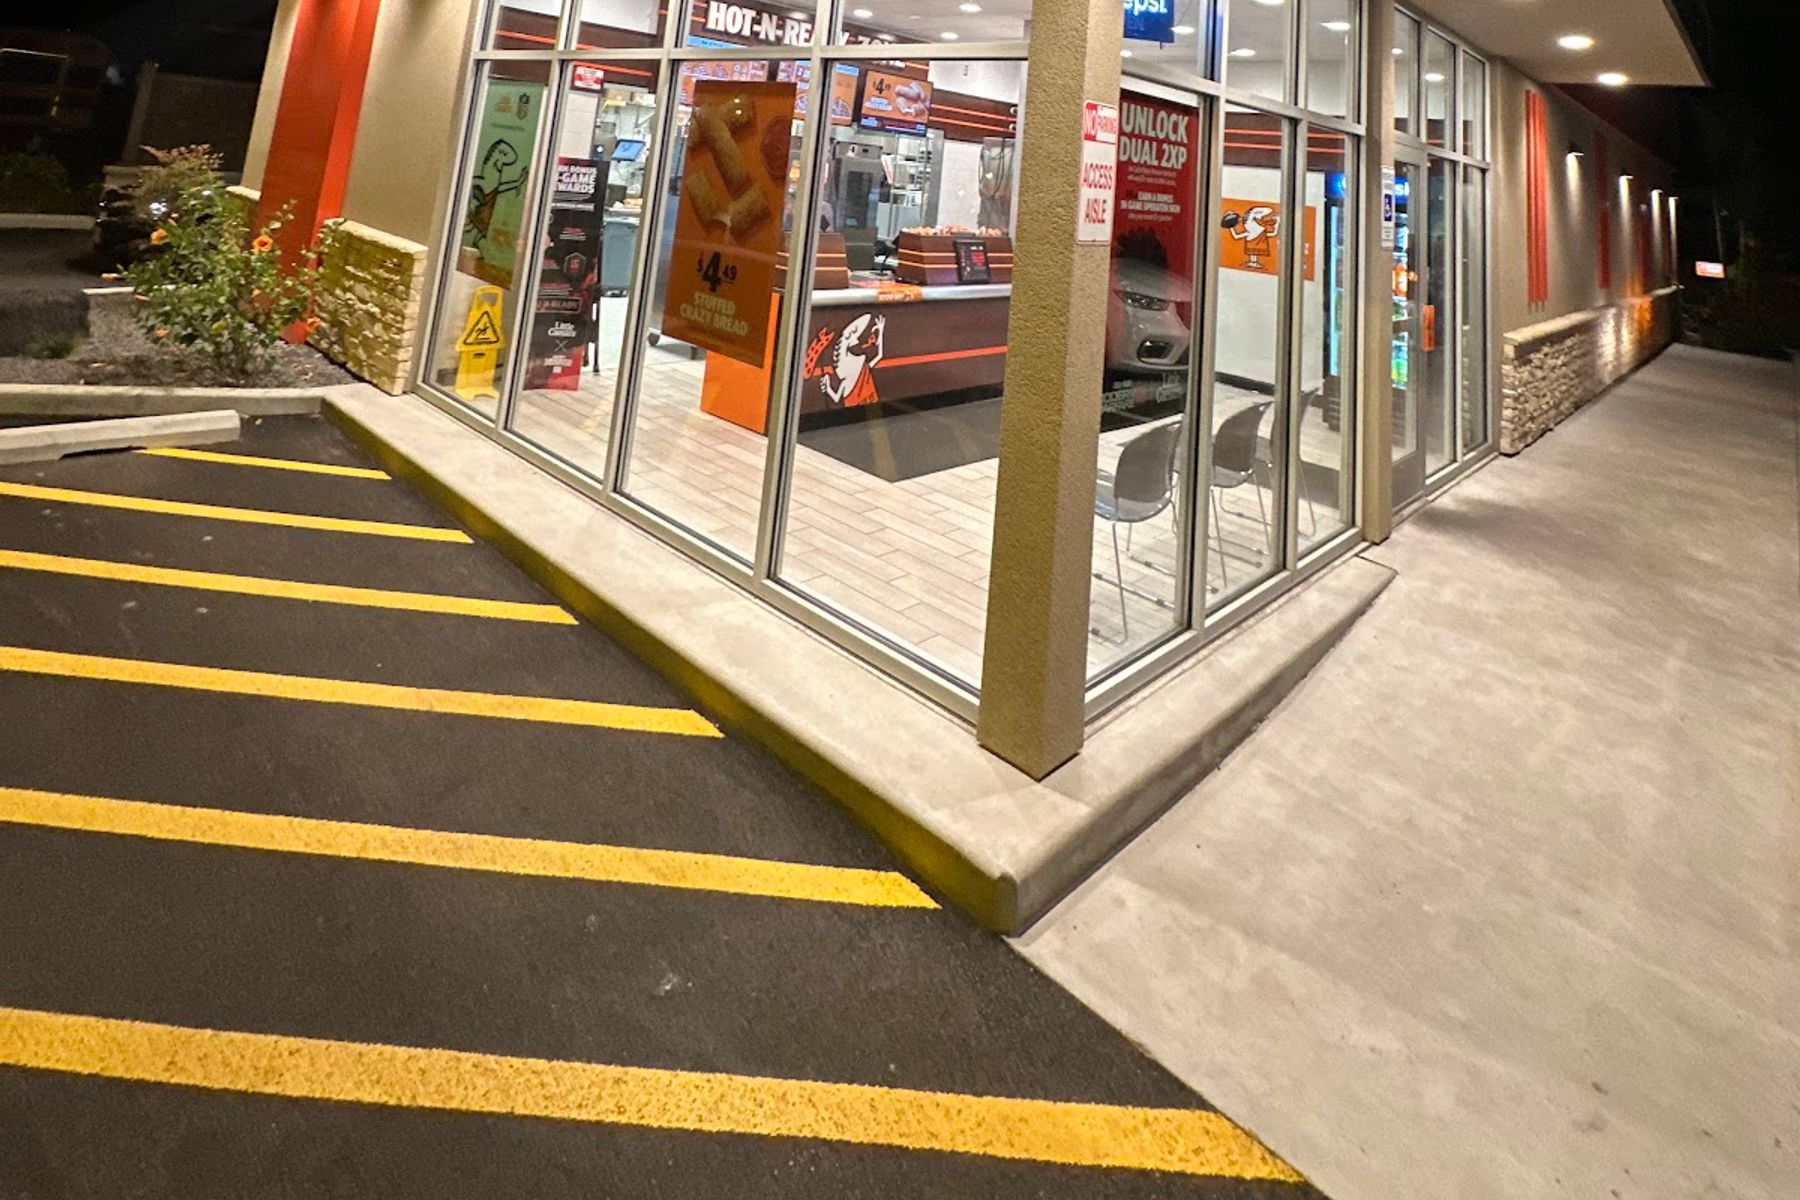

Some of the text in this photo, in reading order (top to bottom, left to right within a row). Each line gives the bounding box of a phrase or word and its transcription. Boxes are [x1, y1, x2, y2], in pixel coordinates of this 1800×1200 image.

[1121, 102, 1189, 143] UNLOCK
[1119, 136, 1188, 169] DUAL 2XP
[1083, 162, 1113, 190] ACCESS
[1085, 198, 1106, 224] AISLE
[693, 291, 736, 316] STUFFED
[681, 303, 748, 337] CRAZY BREAD
